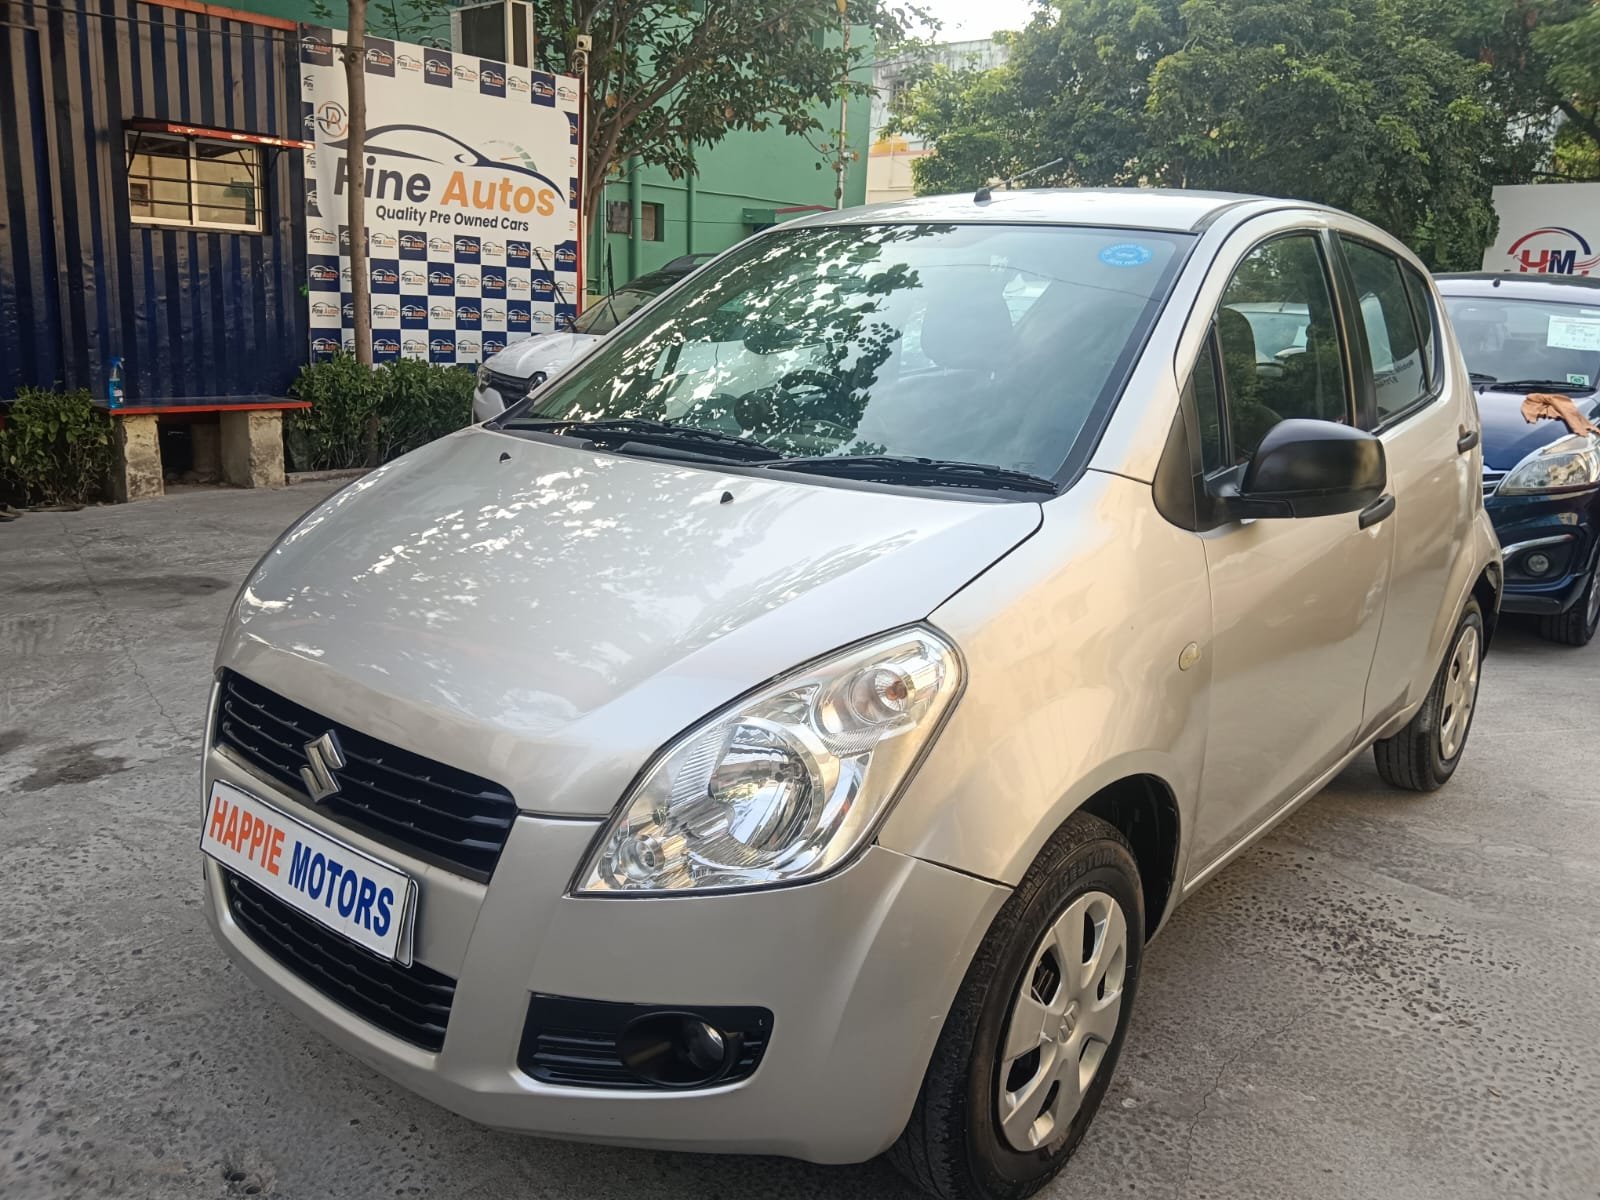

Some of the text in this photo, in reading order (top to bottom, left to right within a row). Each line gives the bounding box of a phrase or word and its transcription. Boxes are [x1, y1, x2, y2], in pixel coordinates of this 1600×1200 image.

[441, 171, 555, 216] Autos
[376, 205, 529, 231] Quality Pre Owned Cars
[1520, 250, 1576, 274] HM
[209, 796, 394, 936] HAPPIE MOTORS
